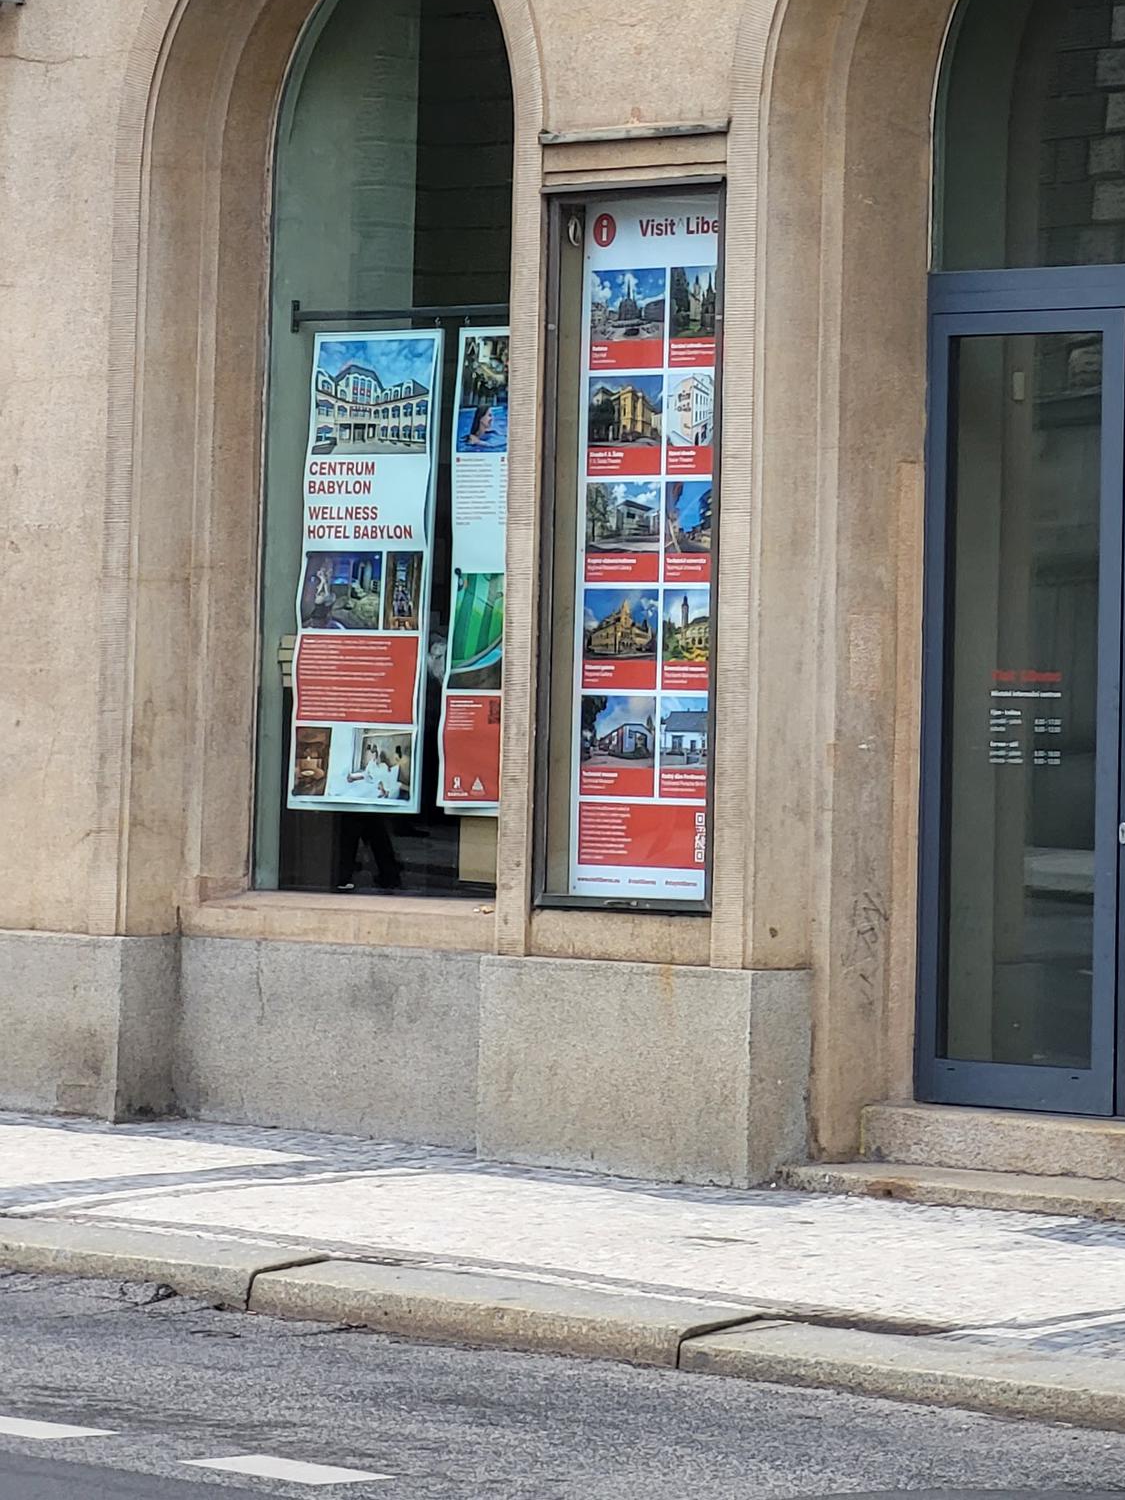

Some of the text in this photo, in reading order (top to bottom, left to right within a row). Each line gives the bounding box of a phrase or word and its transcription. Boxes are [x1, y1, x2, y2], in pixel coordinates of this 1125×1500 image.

[639, 218, 675, 237] Visit
[309, 461, 375, 476] CENTRUM
[308, 481, 371, 494] BABYLON
[308, 506, 378, 520] WELLNESS
[308, 525, 413, 539] HOTEL BABYLON
